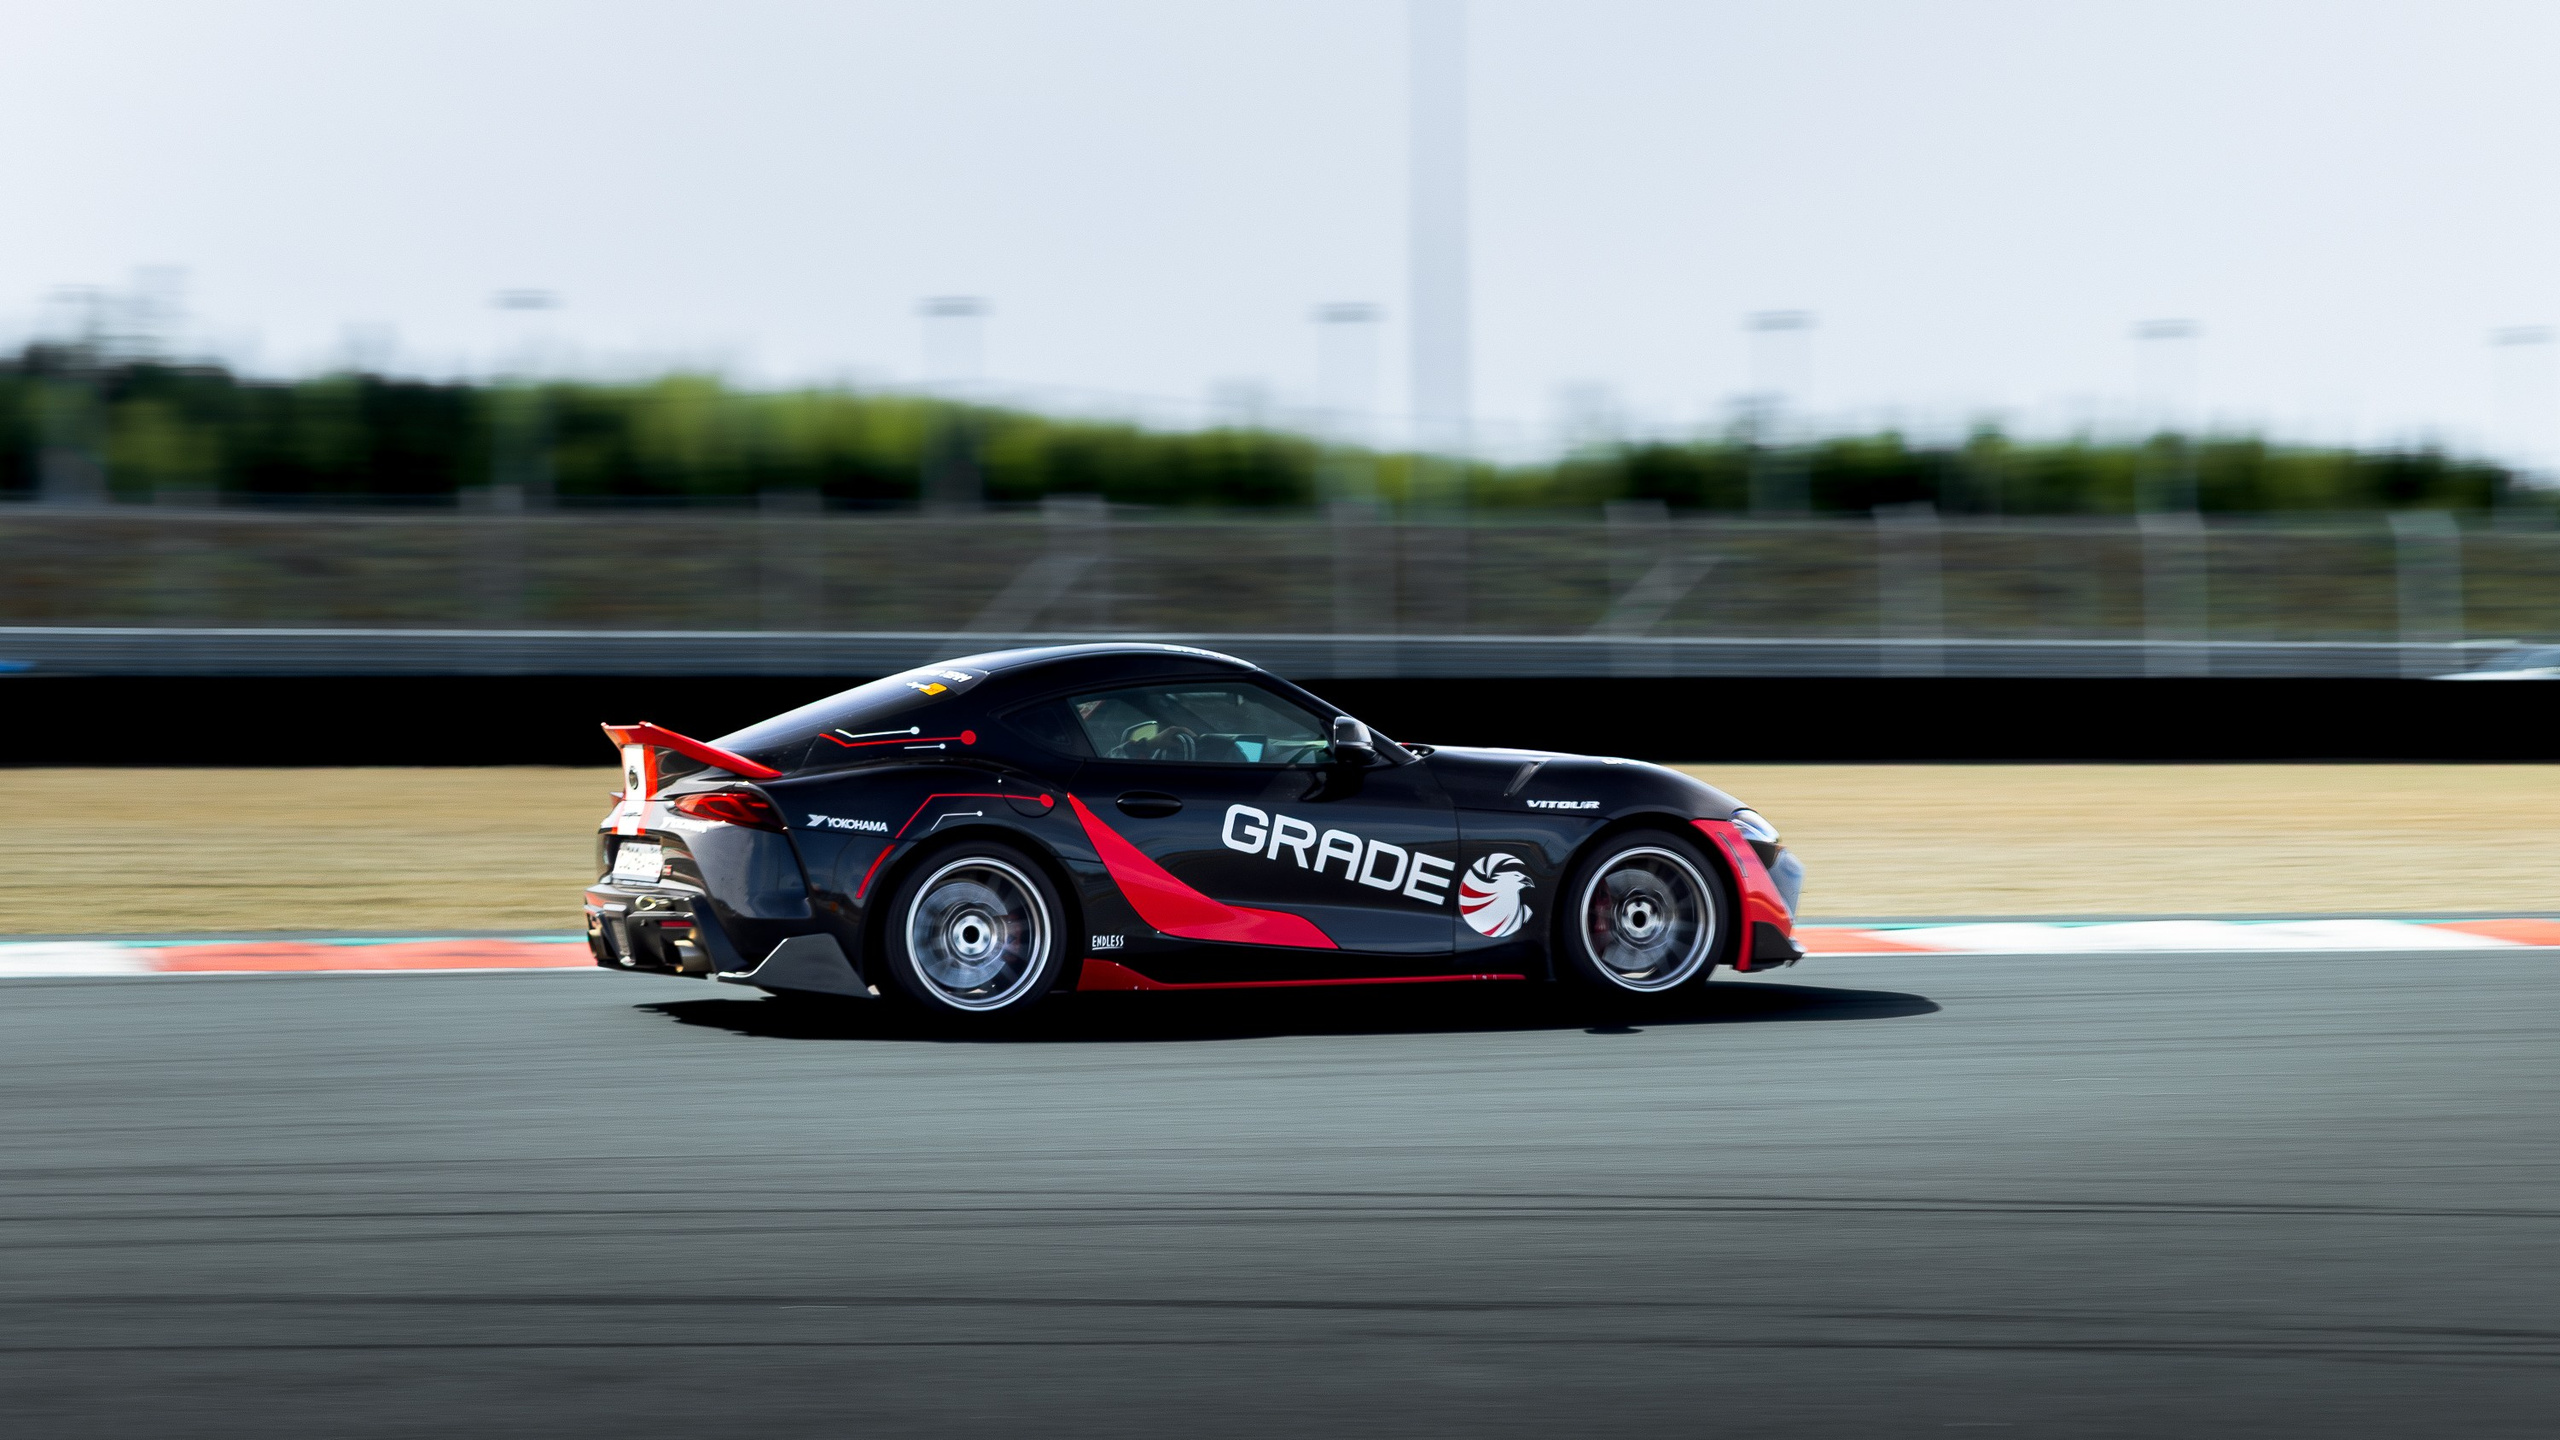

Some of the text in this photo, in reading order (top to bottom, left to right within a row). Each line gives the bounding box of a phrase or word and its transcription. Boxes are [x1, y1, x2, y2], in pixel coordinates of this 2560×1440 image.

[1526, 800, 1600, 809] VITOUR
[827, 817, 888, 832] YOKOHAMA
[1222, 804, 1455, 905] GRADE
[1092, 935, 1124, 948] ENDLESS
